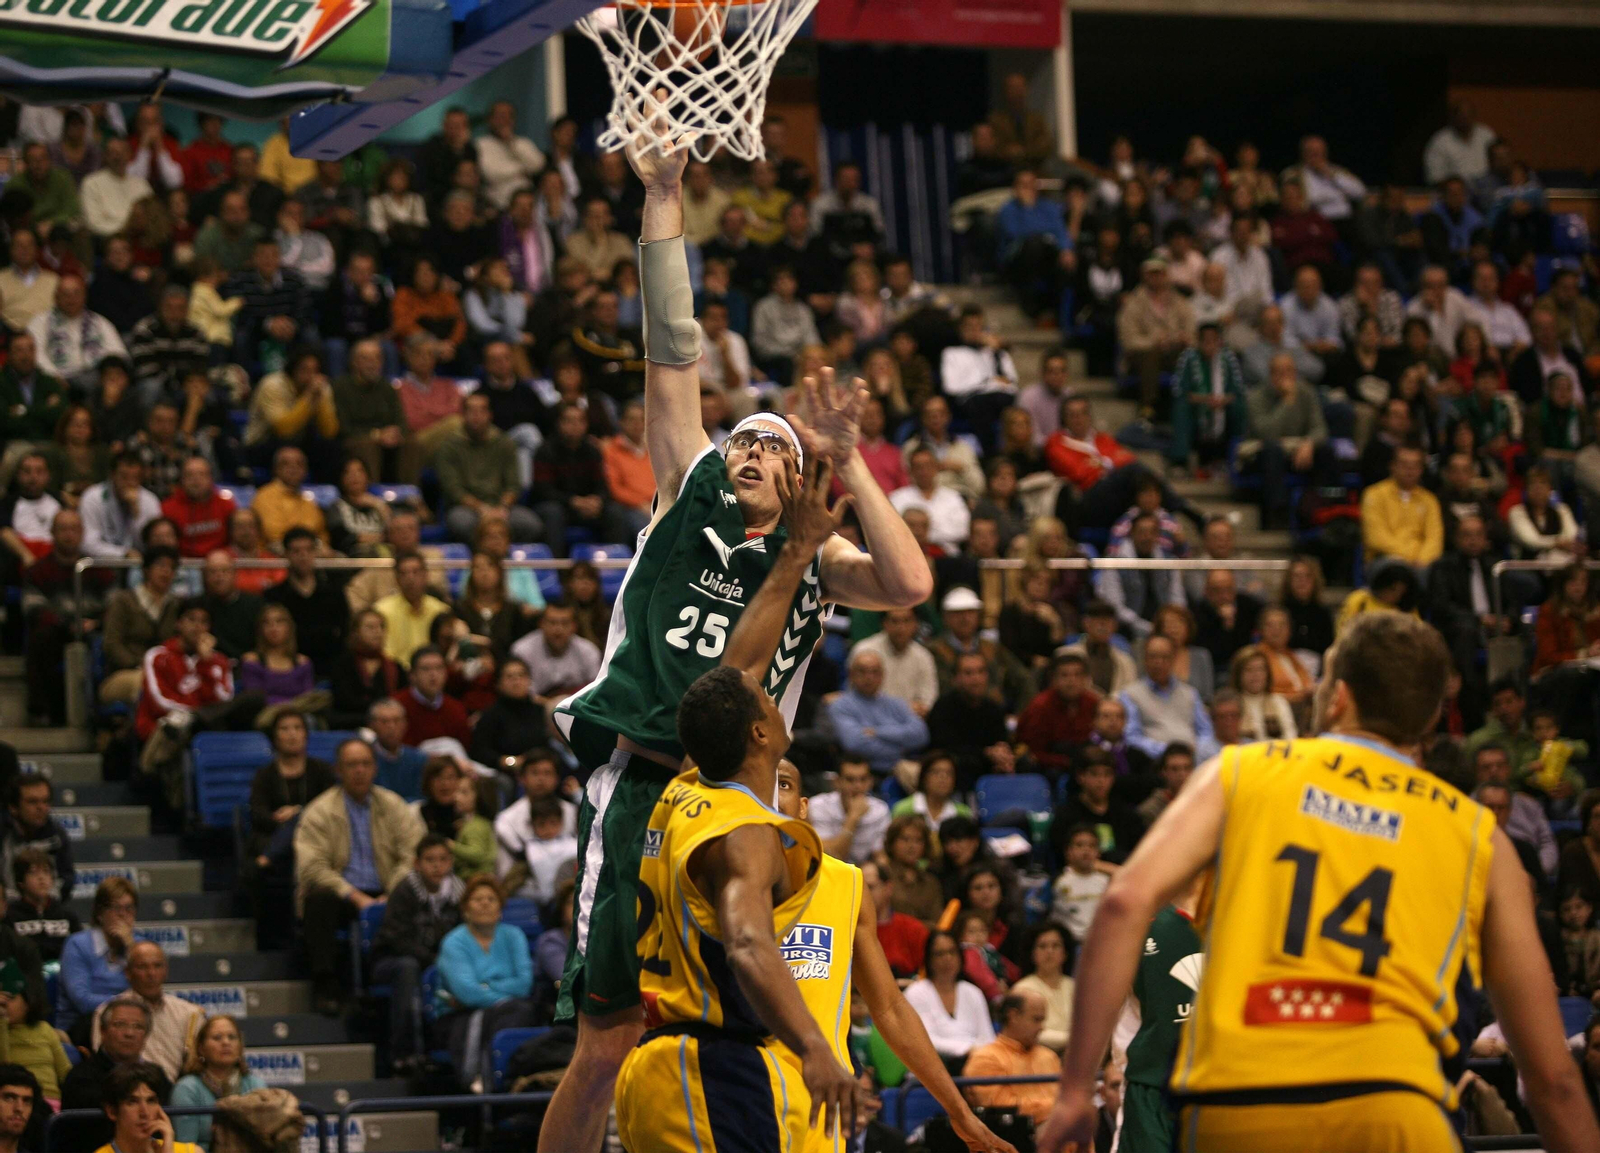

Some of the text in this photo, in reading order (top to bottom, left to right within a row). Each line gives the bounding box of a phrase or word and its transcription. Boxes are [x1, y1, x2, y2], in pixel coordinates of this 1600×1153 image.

[700, 568, 744, 599] Unicaja
[665, 605, 730, 658] 25
[659, 783, 713, 818] EWIS
[1322, 754, 1458, 812] JASEN
[1275, 843, 1395, 978] 14
[782, 926, 829, 947] MT
